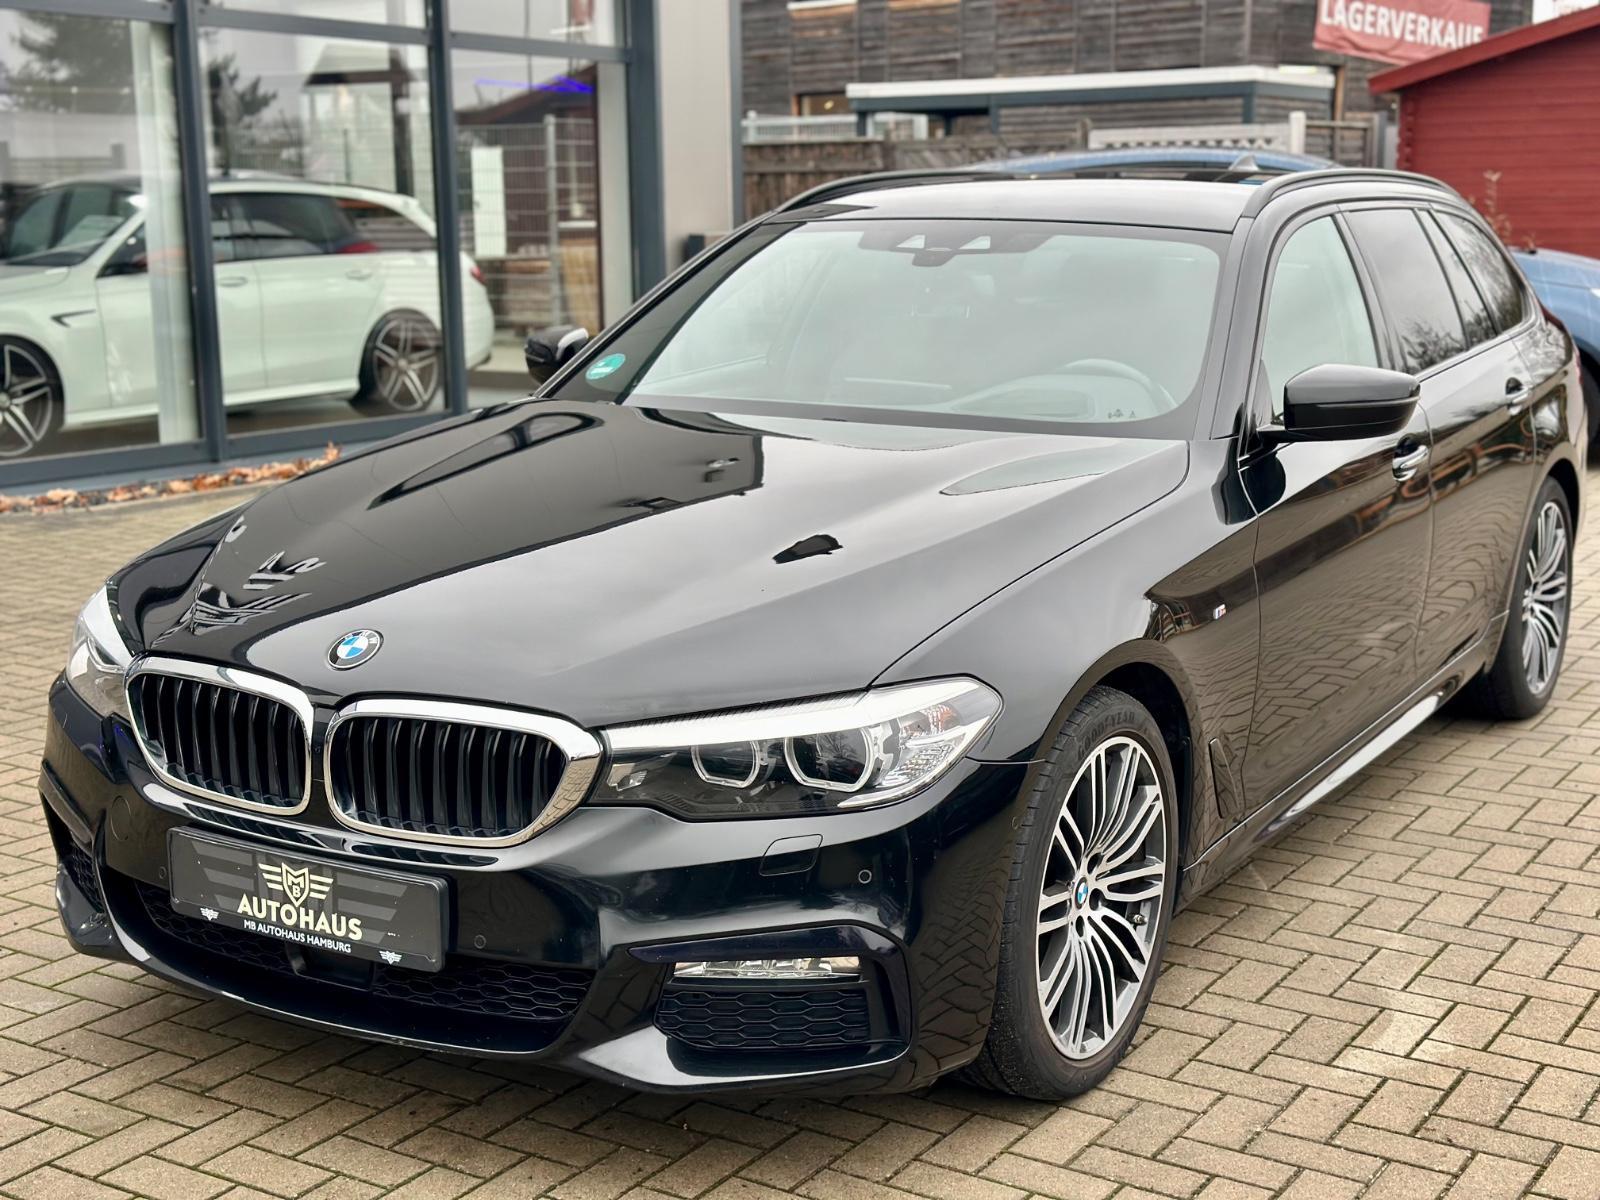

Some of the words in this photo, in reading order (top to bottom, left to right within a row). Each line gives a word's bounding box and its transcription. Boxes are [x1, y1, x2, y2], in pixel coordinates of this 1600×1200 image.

[1321, 0, 1483, 49] LAGERVERKAUF
[237, 893, 363, 941] AUTOHAUS
[244, 919, 256, 931] MB
[257, 922, 305, 943] AUTOHAUS
[306, 934, 352, 953] HAMBURG
